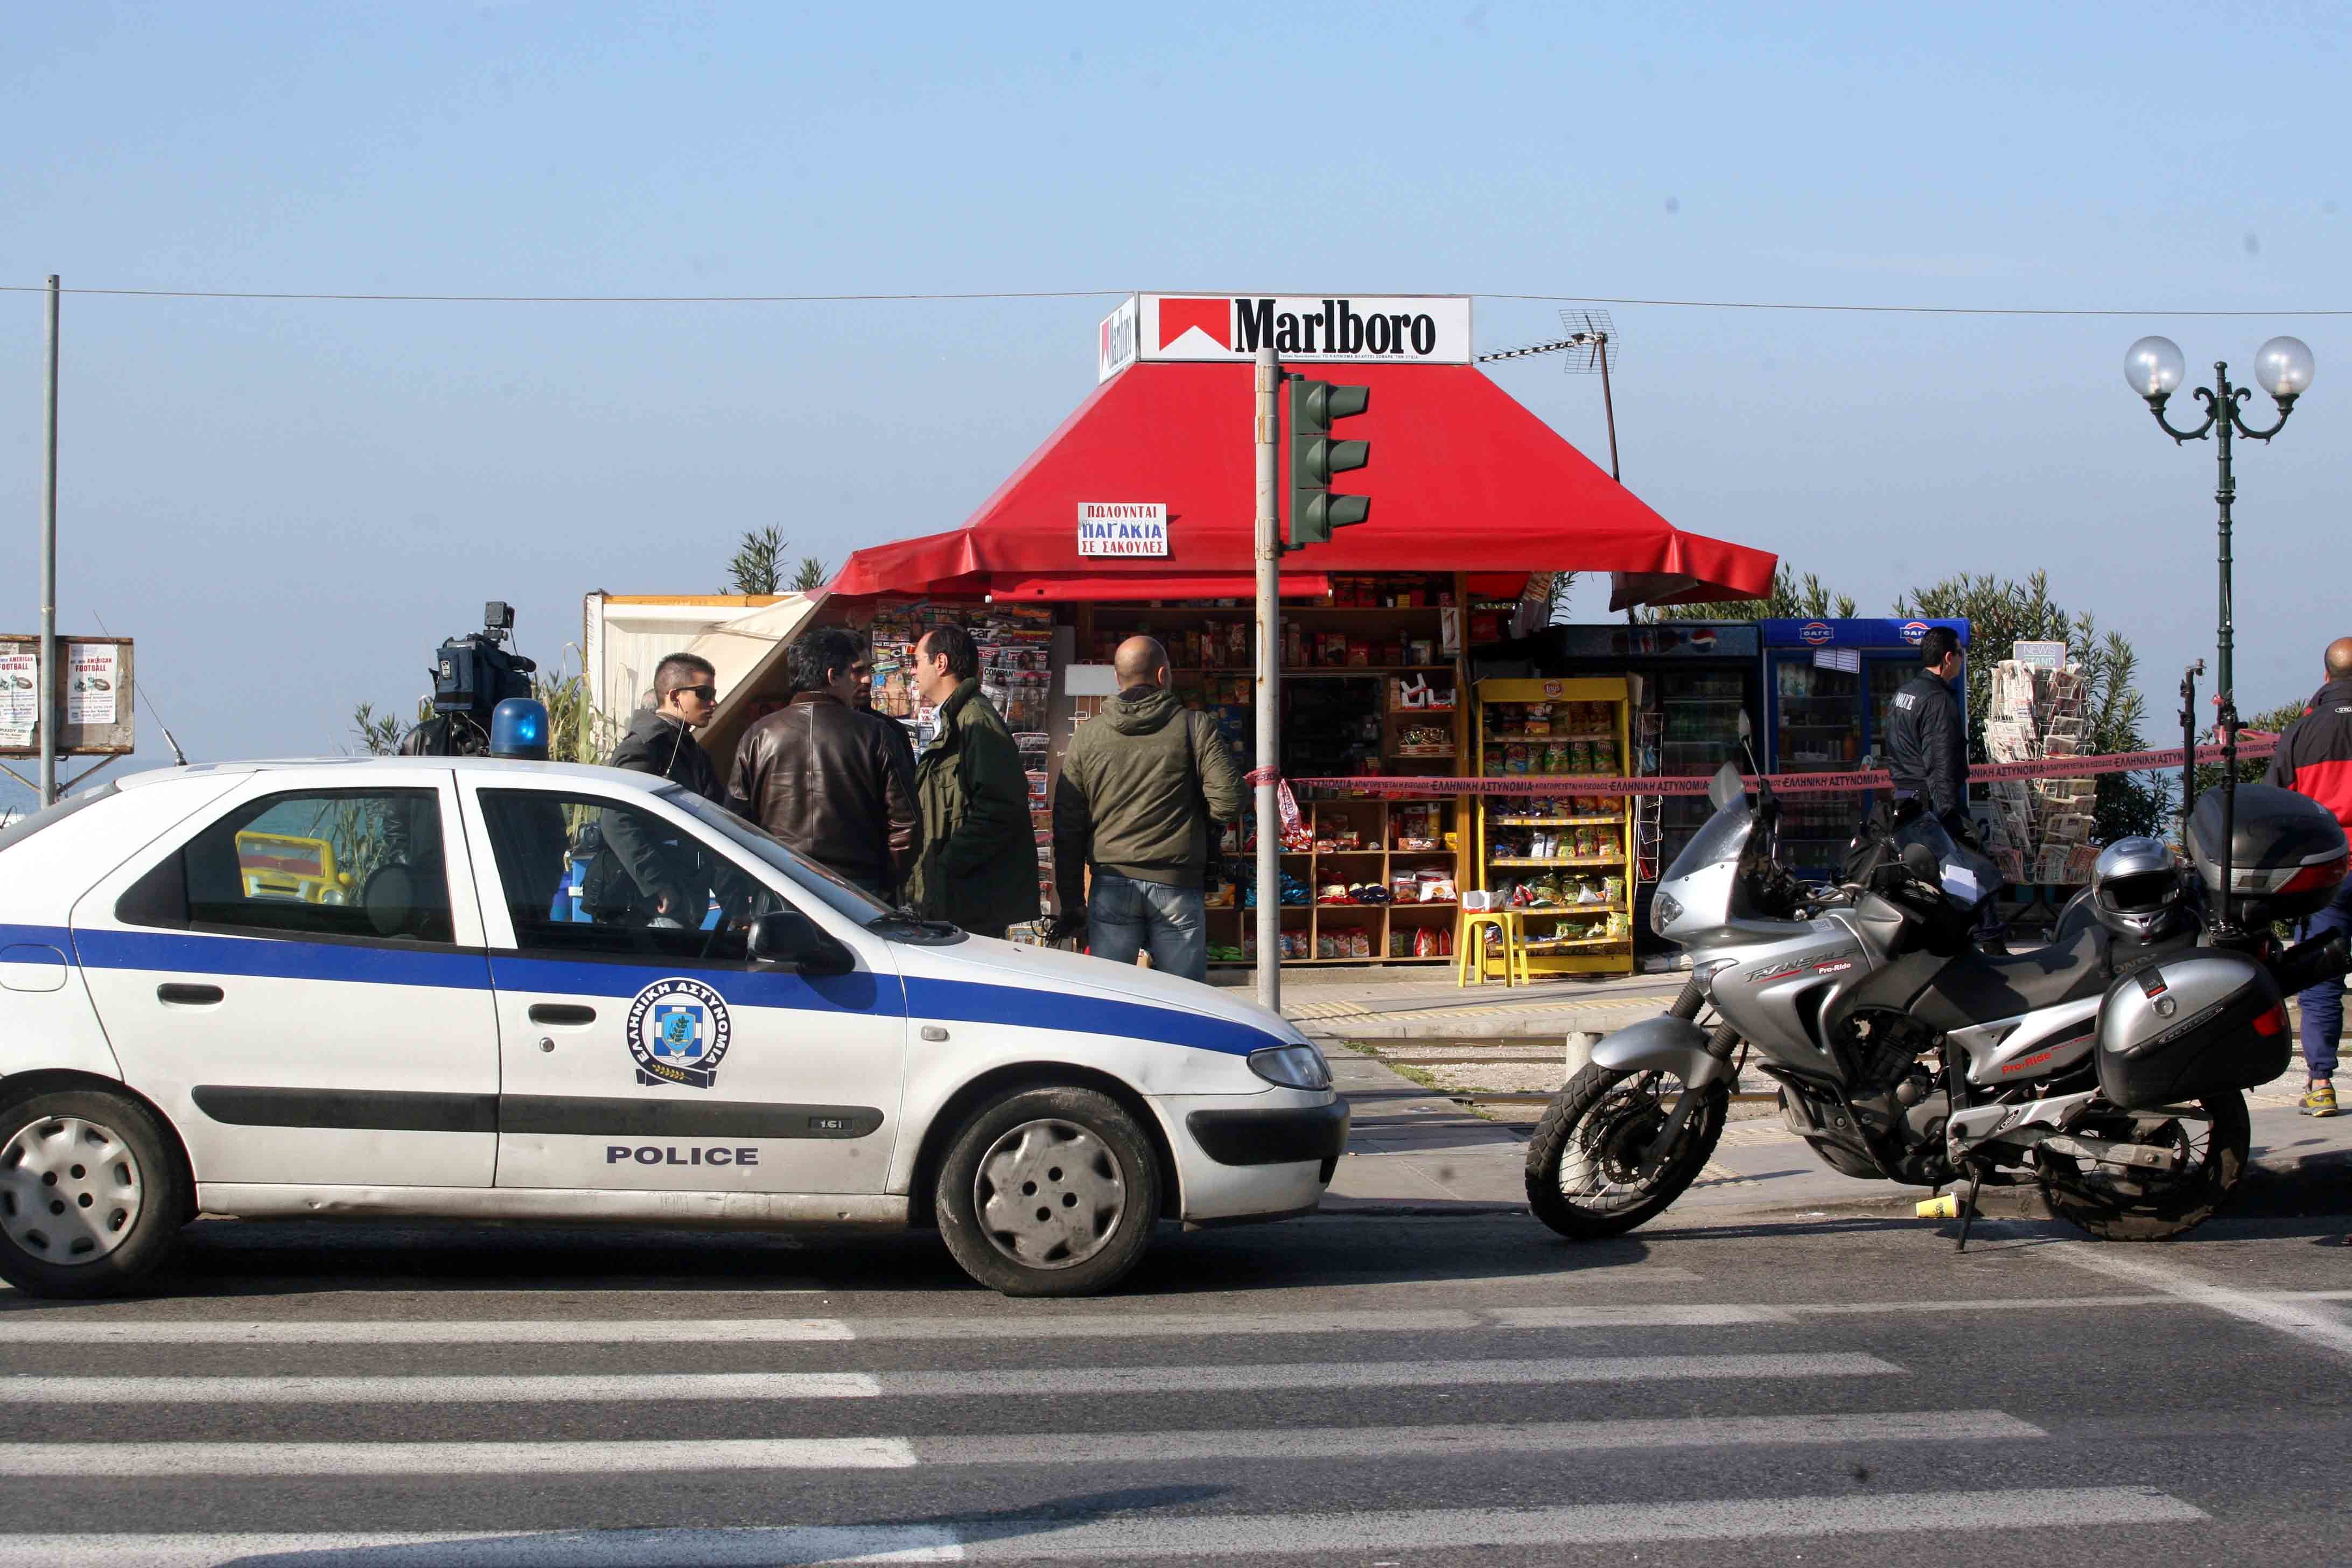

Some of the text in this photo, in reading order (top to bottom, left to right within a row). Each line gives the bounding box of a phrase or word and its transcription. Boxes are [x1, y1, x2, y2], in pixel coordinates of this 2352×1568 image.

[1235, 298, 1436, 355] Marlboro
[1087, 505, 1157, 518] ΠΩΛΟΥΝΤΑΙ
[1082, 520, 1162, 538] ΠΑΓΑΚΙΑ
[1082, 541, 1164, 554] ΣΕ ΣΑΚΟΥΛΕΣ
[2023, 645, 2055, 655] NEWS
[75, 664, 107, 672] FOOTBALL
[1969, 768, 1993, 779] ΗΝΙΚΗ
[1996, 765, 2044, 776] ΑΣΤΥΝΟΜΙΑ
[2115, 755, 2156, 767] ΕΛΛΗΝΙΚΗ
[2158, 750, 2204, 763] ΑΣΤΥΝΙΑ
[1432, 781, 1478, 792] ΕΛΛΗΝΙΚΗ
[1481, 781, 1532, 792] ΑΣΤΥΝΟΜΙΑ
[1610, 781, 1655, 792] ΕΛΛΗΝΙΚΗ
[1657, 781, 1708, 792] ΑΣΤΥΝΟΜΙΑ
[1783, 777, 1827, 788] ΕΛΛΗΝΙΚΗ
[1829, 775, 1879, 786] ΑΣΤΥΝΟΜΙΑ
[1744, 948, 1857, 983] TRANSALP
[1818, 962, 1851, 974] Pro-Ride
[628, 982, 729, 1064] ΕΛΛΗΝΙΚΗ ΑΣΤΥΝΟΜΙΑ
[607, 1146, 759, 1165] POLICE
